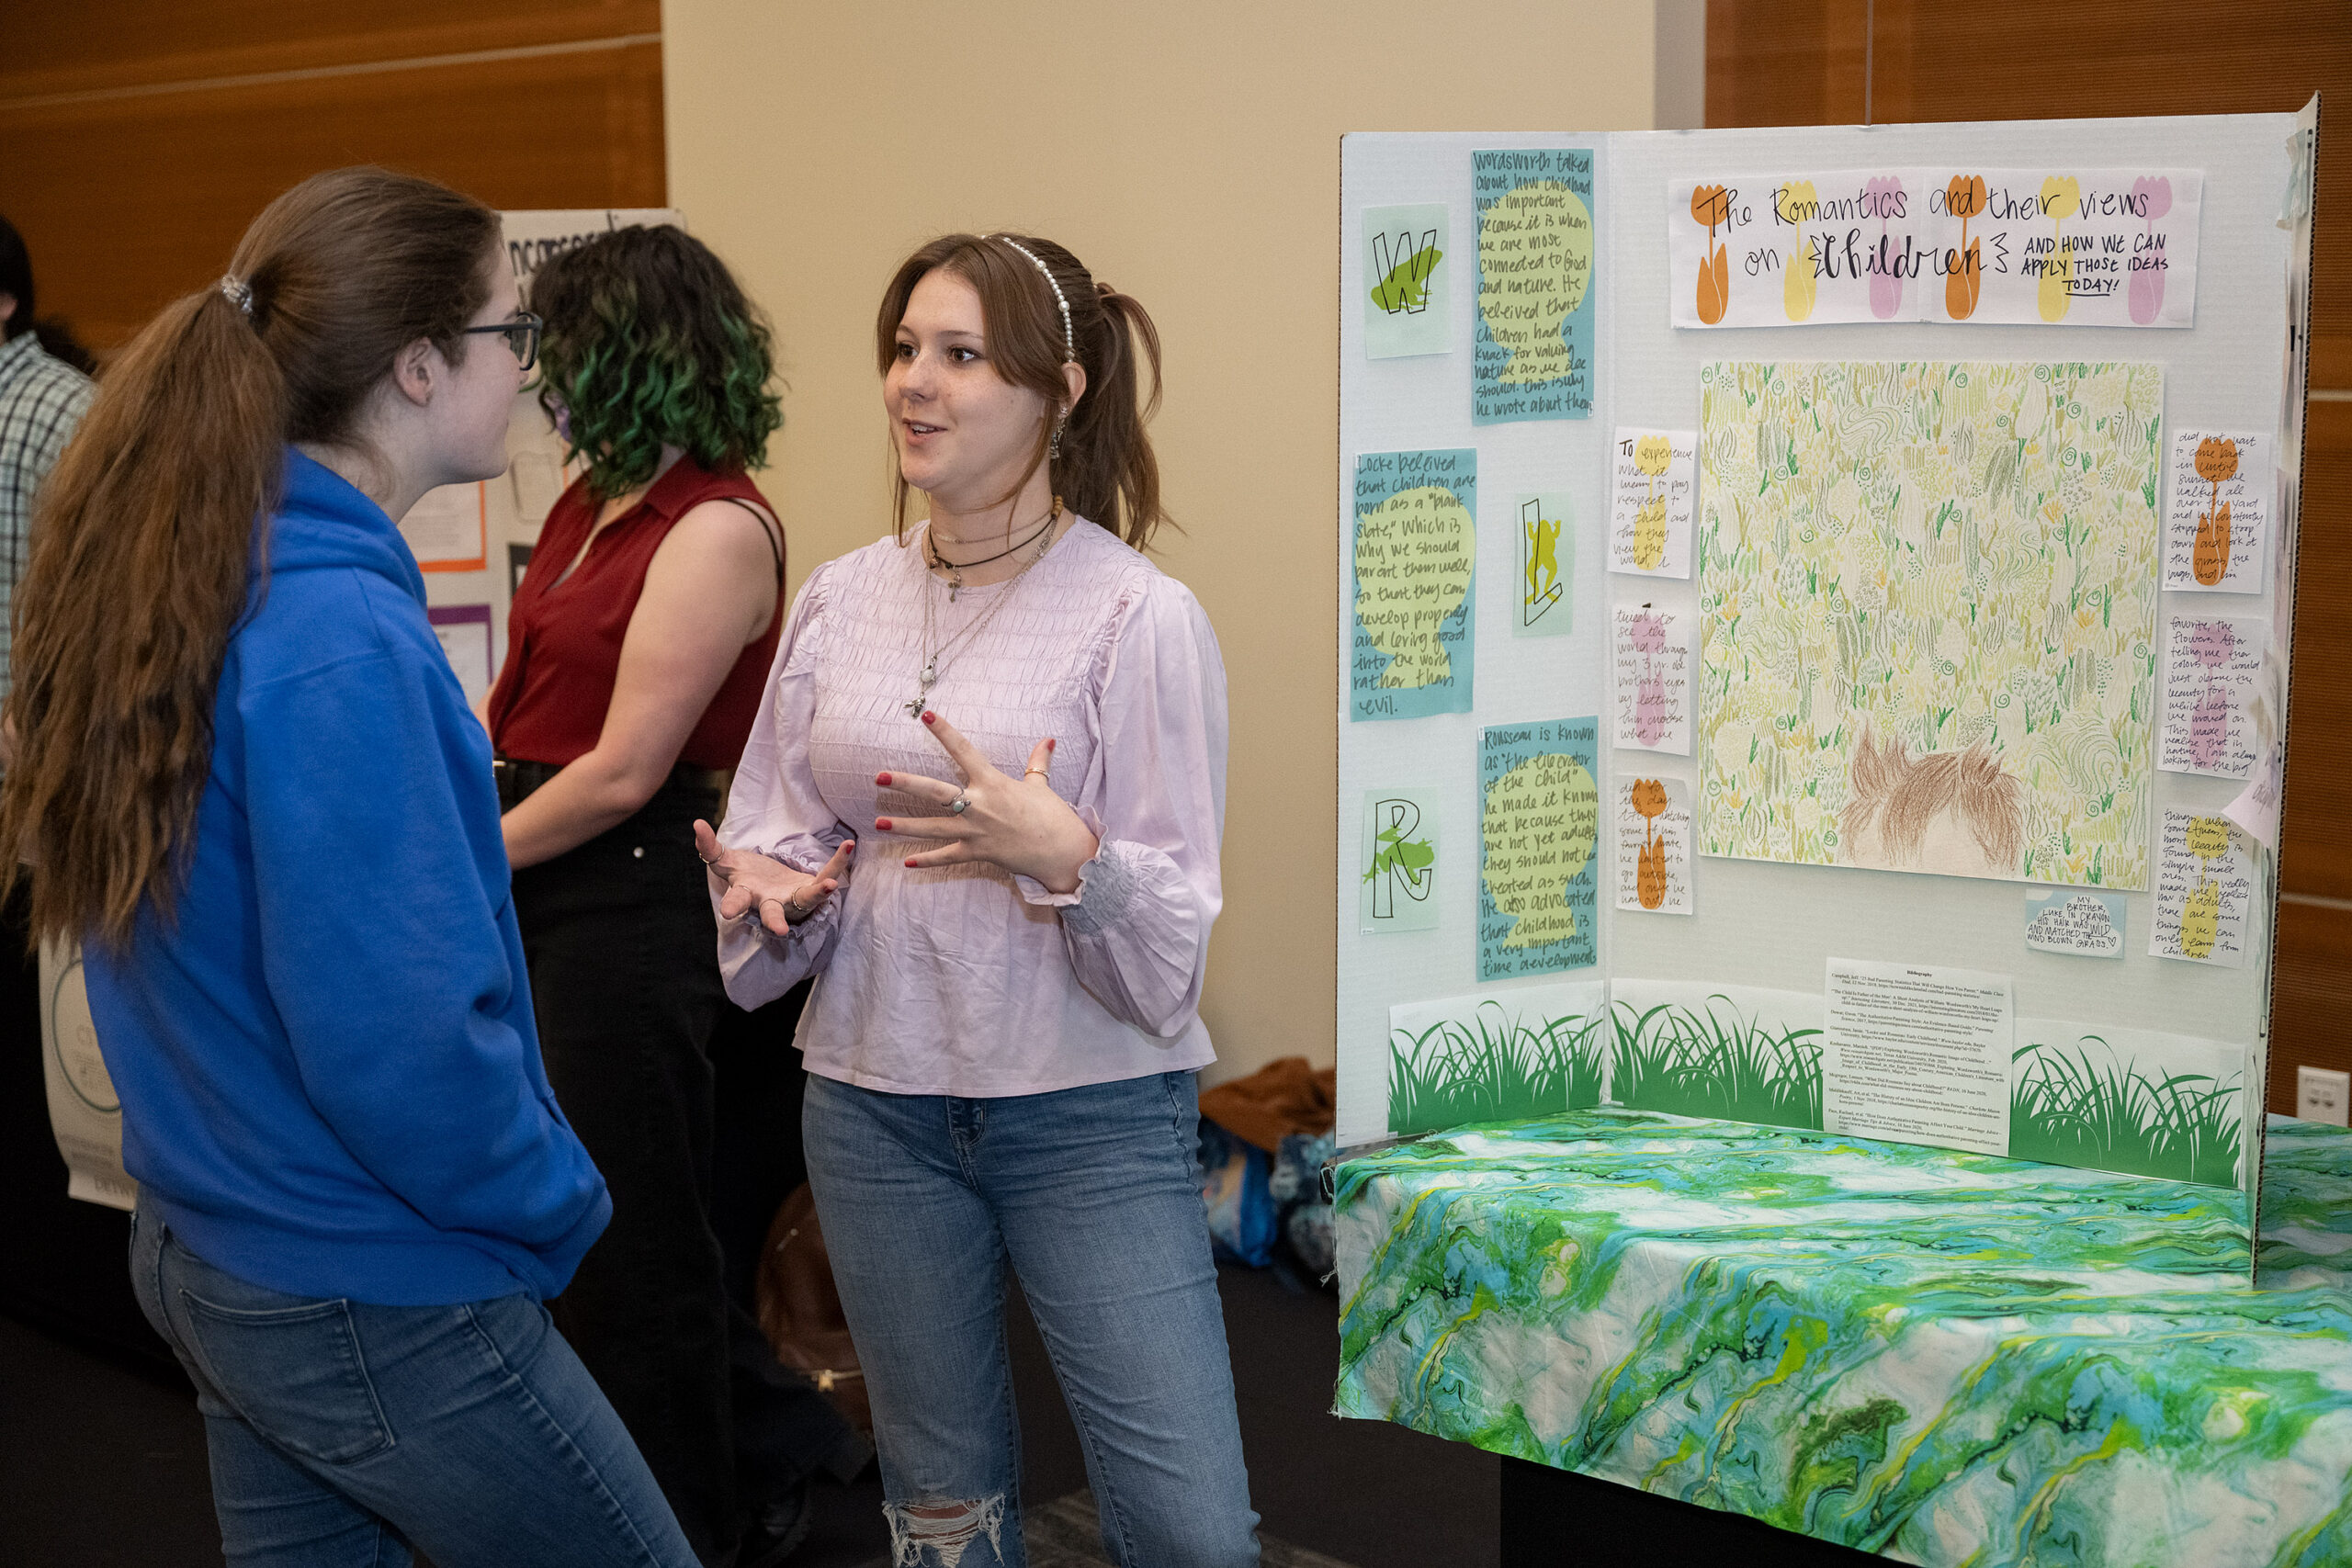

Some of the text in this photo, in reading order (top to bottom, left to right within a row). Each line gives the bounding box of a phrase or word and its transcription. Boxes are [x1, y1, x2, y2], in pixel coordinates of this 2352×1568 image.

[1557, 152, 1589, 173] talked
[1476, 174, 1538, 191] about how
[1476, 195, 1566, 217] was important
[1696, 180, 2148, 238] The Romantics and their views
[1477, 213, 1521, 234] because
[1525, 215, 1540, 231] it
[1559, 212, 1587, 230] when
[1478, 233, 1561, 252] we are most
[2025, 237, 2055, 254] AND
[2062, 236, 2094, 253] HOW
[2133, 233, 2165, 252] CAN
[1548, 253, 1562, 268] to
[1564, 249, 1587, 272] God
[1746, 248, 1780, 276] on
[2021, 257, 2169, 278] APPLY THOSE IDEAS
[1373, 230, 1437, 314] W
[1478, 275, 1580, 294] and nature. He
[2062, 278, 2120, 292] TODAY!
[1546, 297, 1579, 316] that
[1534, 322, 1559, 339] had
[1563, 325, 1572, 336] a
[1514, 346, 1531, 359] for
[1535, 344, 1574, 362] valuing
[1475, 363, 1560, 379] nature as we
[1476, 381, 1519, 399] should.
[1476, 400, 1490, 416] he
[1494, 399, 1525, 416] wrote
[1531, 395, 1562, 412] about
[1619, 439, 1692, 463] To experience
[2188, 448, 2245, 458] come back
[1359, 455, 1393, 474] Locke
[2199, 461, 2236, 472] until
[1356, 479, 1385, 496] that
[1453, 475, 1476, 489] are
[2225, 485, 2244, 495] all
[1356, 500, 1384, 517] born
[1391, 499, 1408, 511] as
[1415, 499, 1423, 509] a
[1618, 493, 1665, 506] respect
[2232, 499, 2258, 510] yard
[1391, 543, 1409, 557] we
[1416, 540, 1459, 555] should
[1522, 499, 1563, 626] L
[1355, 564, 1397, 585] parent
[1403, 562, 1435, 578] them
[1377, 587, 1411, 602] that
[1414, 583, 1439, 604] they
[1356, 609, 1408, 630] develop
[2216, 622, 2233, 632] the
[1355, 627, 1464, 655] and good
[1354, 652, 1451, 671] into the world
[2173, 660, 2260, 670] colors would
[1354, 669, 1453, 690] rather than
[1360, 695, 1397, 715] evil.
[1485, 729, 1531, 750] Rousseau
[1540, 728, 1550, 740] is
[1485, 755, 1498, 771] as
[1485, 775, 1498, 794] of
[1504, 773, 1523, 792] the
[1485, 798, 1497, 815] he
[1502, 794, 1536, 813] made
[1542, 791, 1558, 807] it
[1482, 814, 1564, 834] that because
[1485, 832, 1555, 852] are not yet
[1374, 799, 1431, 918] R
[1483, 847, 1580, 874] they should not
[1482, 875, 1532, 896] treated
[1538, 878, 1555, 888] as
[2160, 884, 2187, 893] made
[1531, 890, 1595, 911] advocated
[2067, 903, 2106, 913] BROTHER,
[2042, 910, 2064, 919] LUKE,
[2080, 912, 2109, 922] CRAYON
[1481, 922, 1510, 942] that
[1579, 915, 1589, 927] is
[2029, 924, 2090, 940] AND MATCHED THE
[2054, 918, 2069, 927] HAIR
[2089, 923, 2110, 937] WILD
[1484, 932, 1589, 957] a very important
[2027, 934, 2044, 942] WIND
[2076, 940, 2109, 949] GRASS.
[1483, 960, 1511, 976] time
